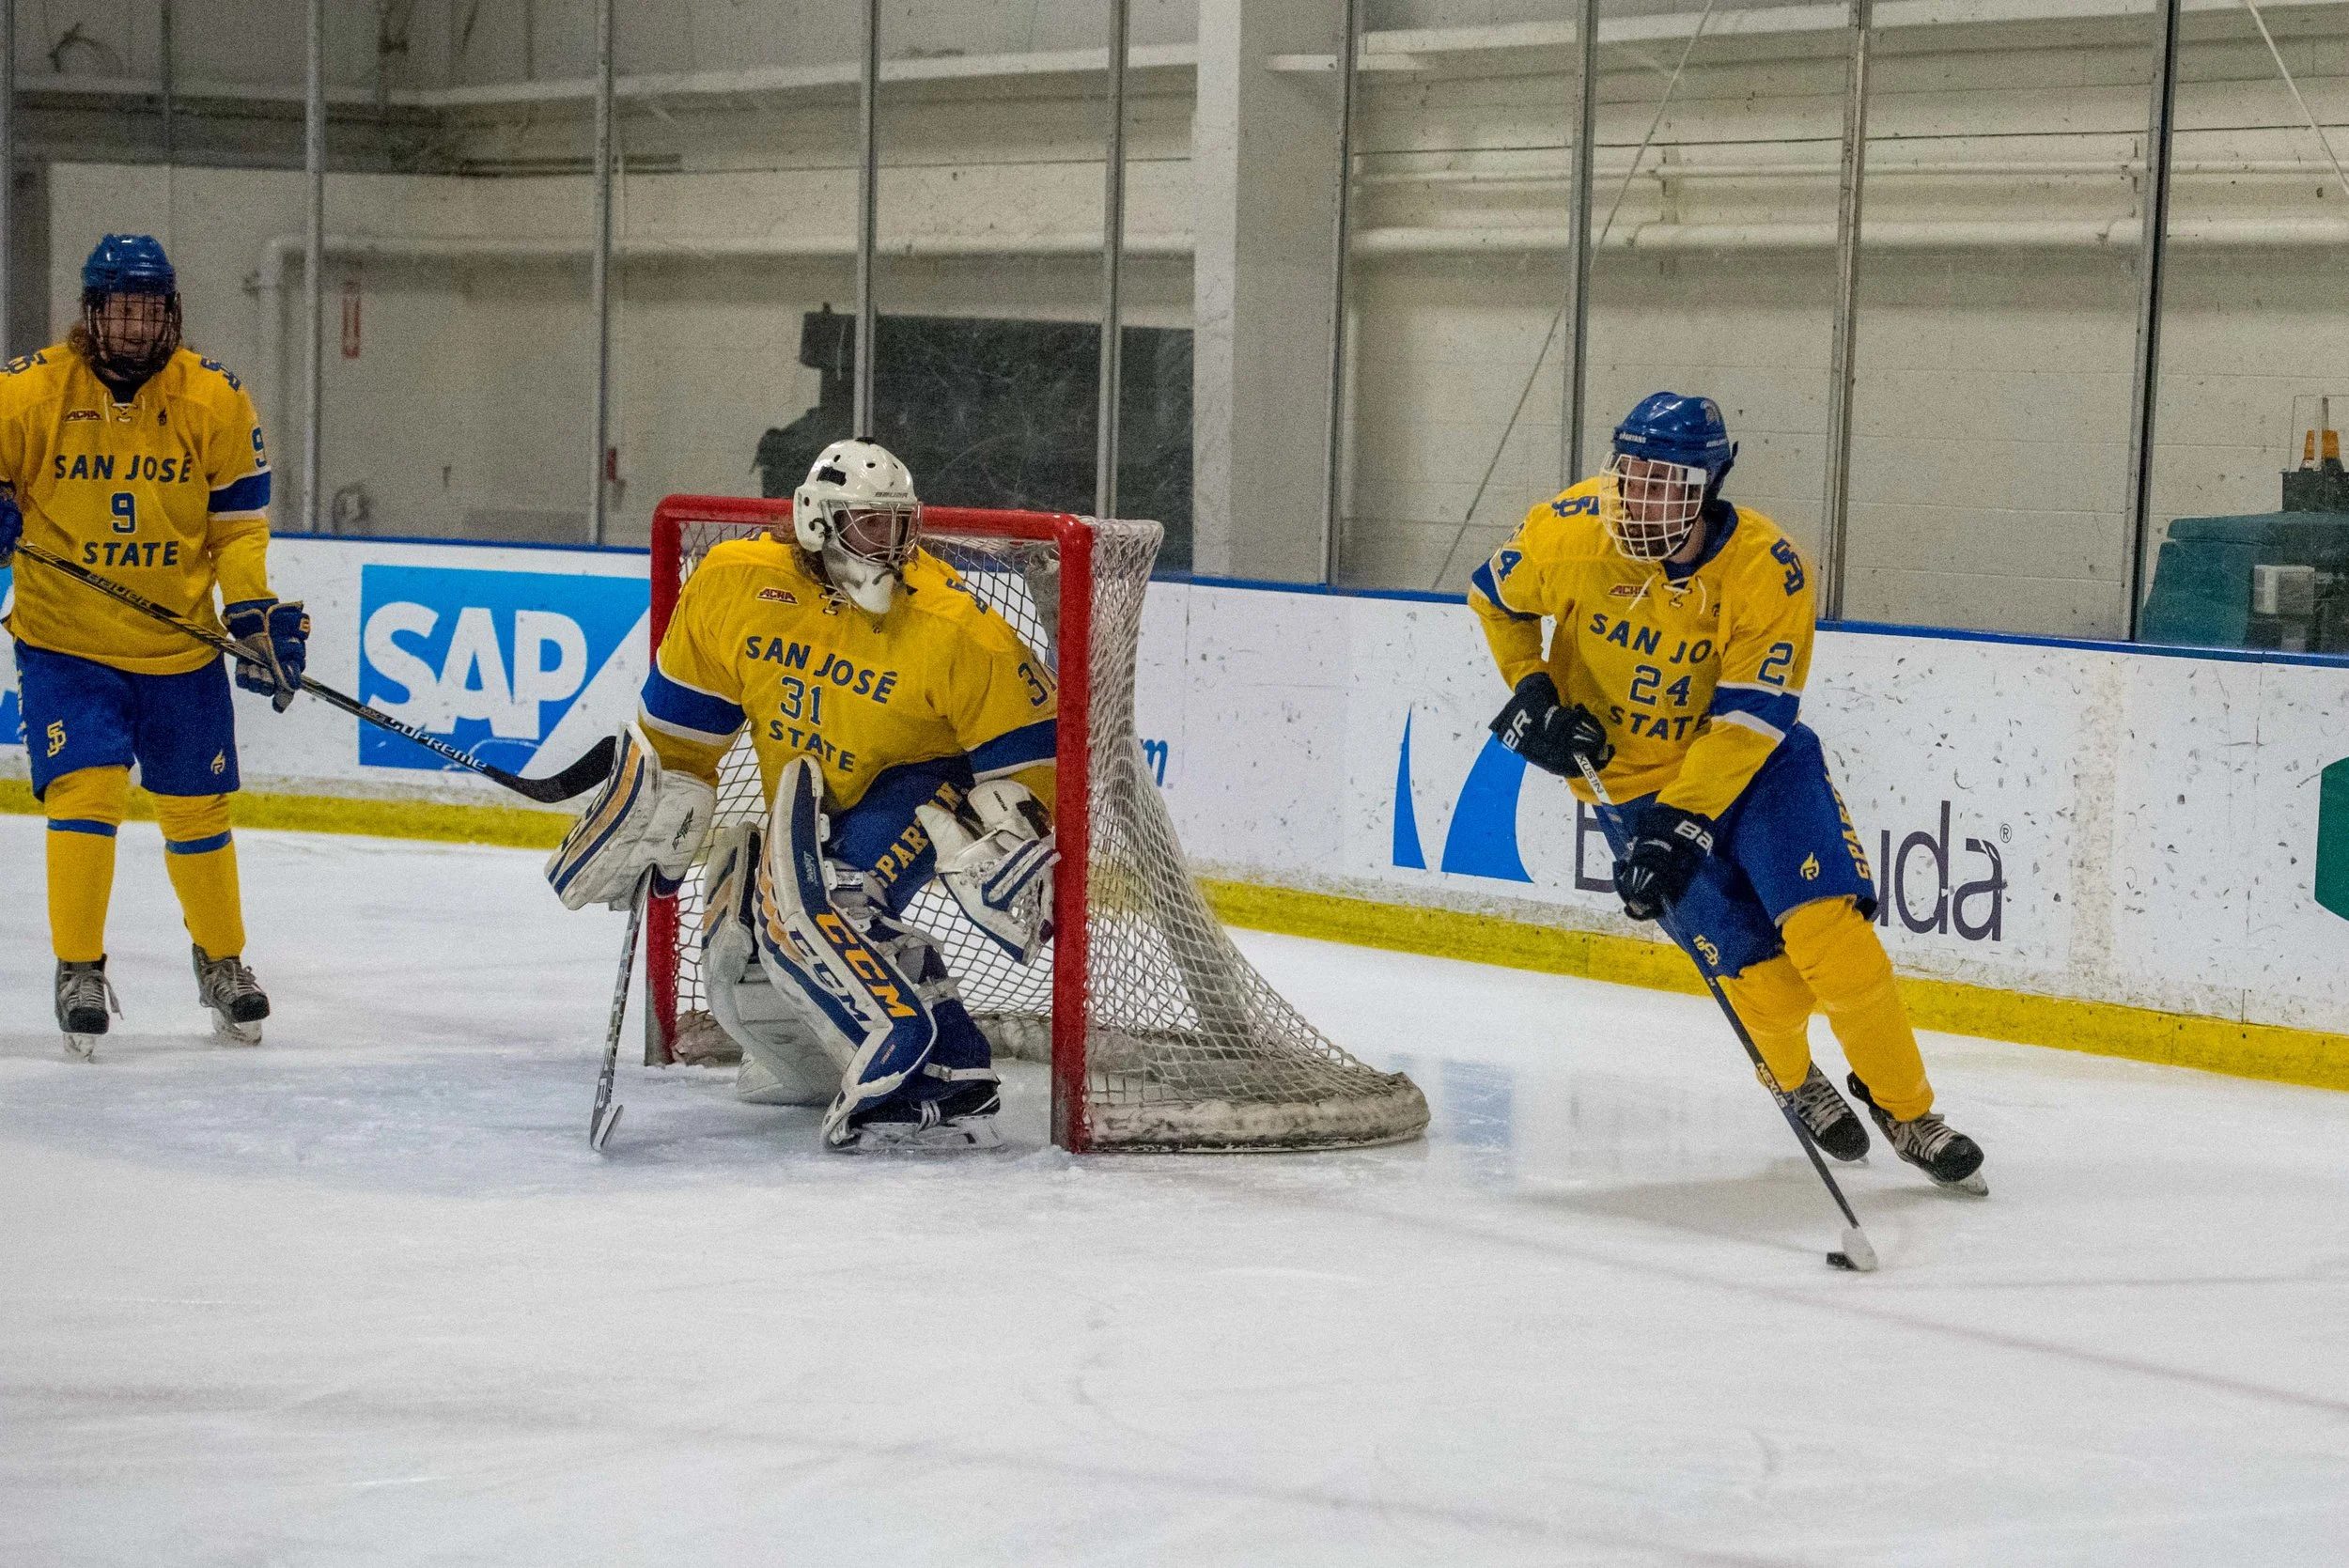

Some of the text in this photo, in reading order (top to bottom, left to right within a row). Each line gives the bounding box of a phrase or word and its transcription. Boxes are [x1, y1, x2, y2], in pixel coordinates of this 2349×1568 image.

[54, 451, 193, 483] SAN JOSÉ
[111, 491, 136, 535] 9
[83, 540, 179, 567] STATE
[758, 587, 798, 604] ACHA
[1589, 613, 1662, 656] SAN
[364, 600, 587, 739] SAP
[745, 635, 898, 705] SAN JOSÉ
[1629, 663, 1693, 707] 24
[1758, 642, 1794, 687] 2
[780, 675, 822, 726] 31
[1608, 705, 1709, 741] STATE
[769, 719, 856, 773] STATE
[866, 781, 963, 889] PARN
[788, 926, 873, 1022] CCM
[816, 911, 918, 1017] CCM
[1756, 1062, 1789, 1109] NEXUS
